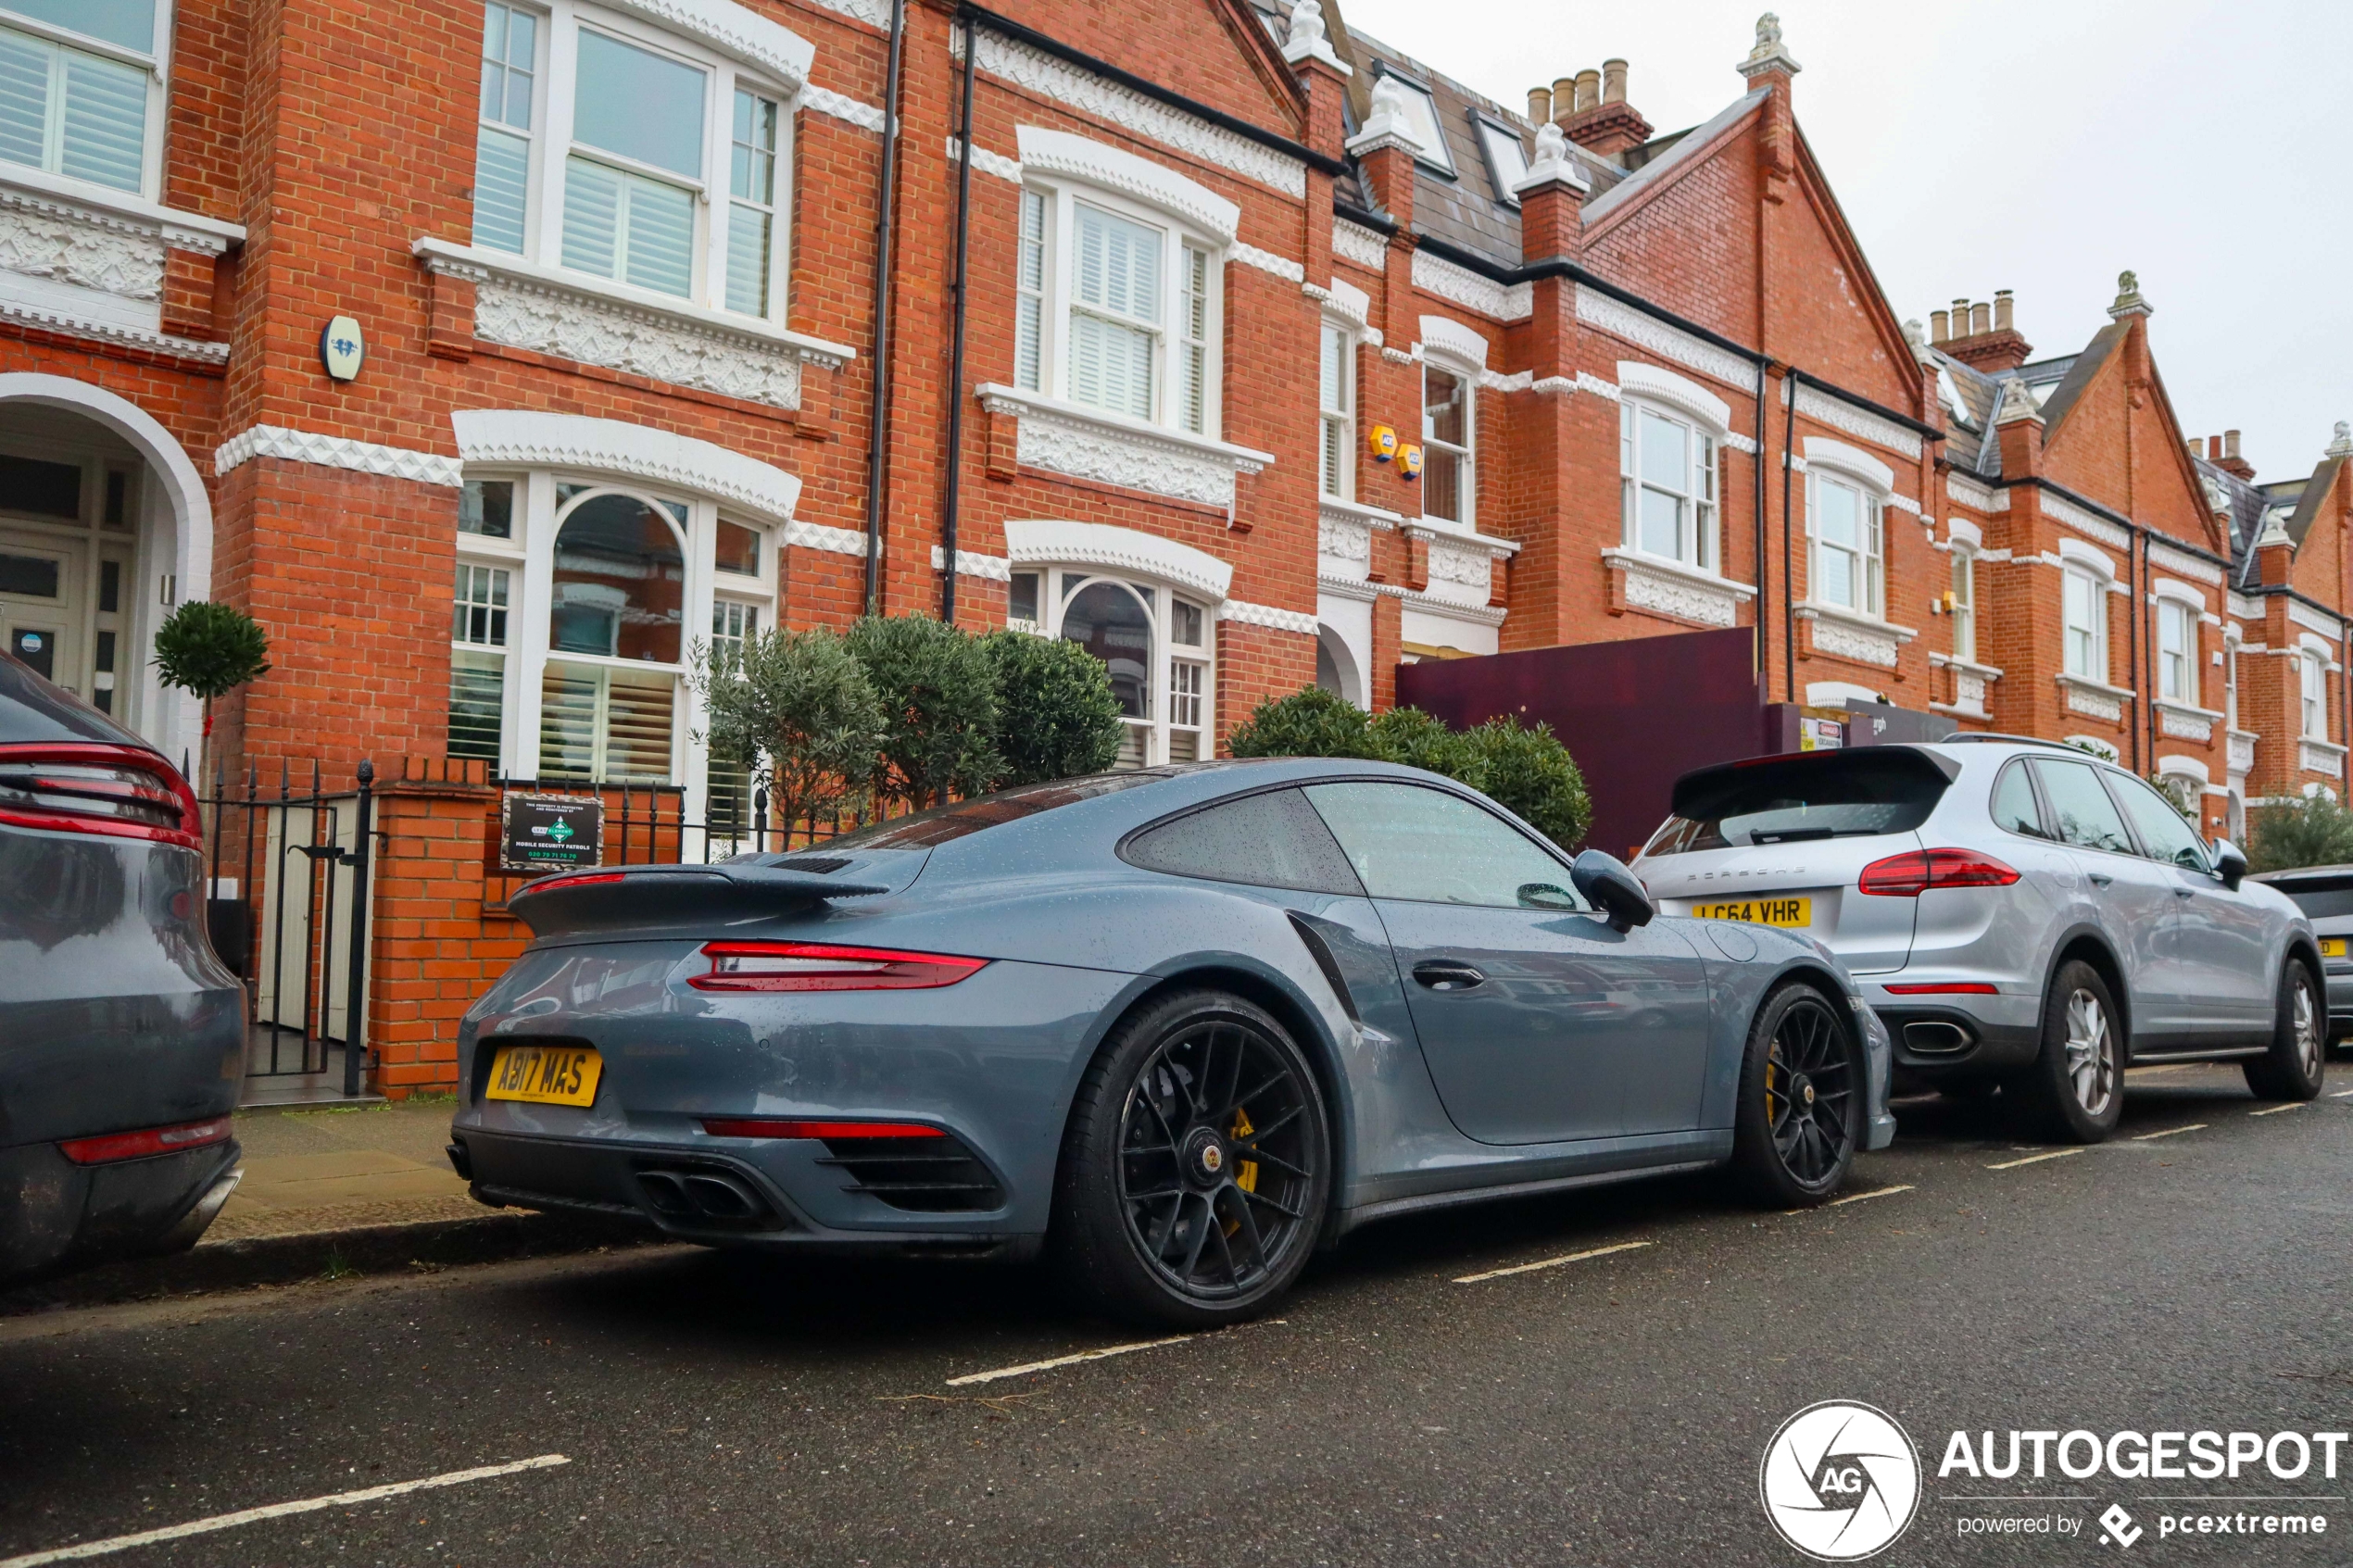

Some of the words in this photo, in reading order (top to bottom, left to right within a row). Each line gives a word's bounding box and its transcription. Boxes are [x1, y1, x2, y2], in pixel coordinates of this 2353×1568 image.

[1382, 436, 1393, 446] ADT
[1409, 454, 1419, 464] ADT
[1820, 724, 1838, 734] DANGER
[1687, 866, 1806, 882] PORSCHE
[1759, 899, 1801, 922] VHR
[497, 1051, 542, 1092] AB17
[538, 1052, 586, 1095] MAS
